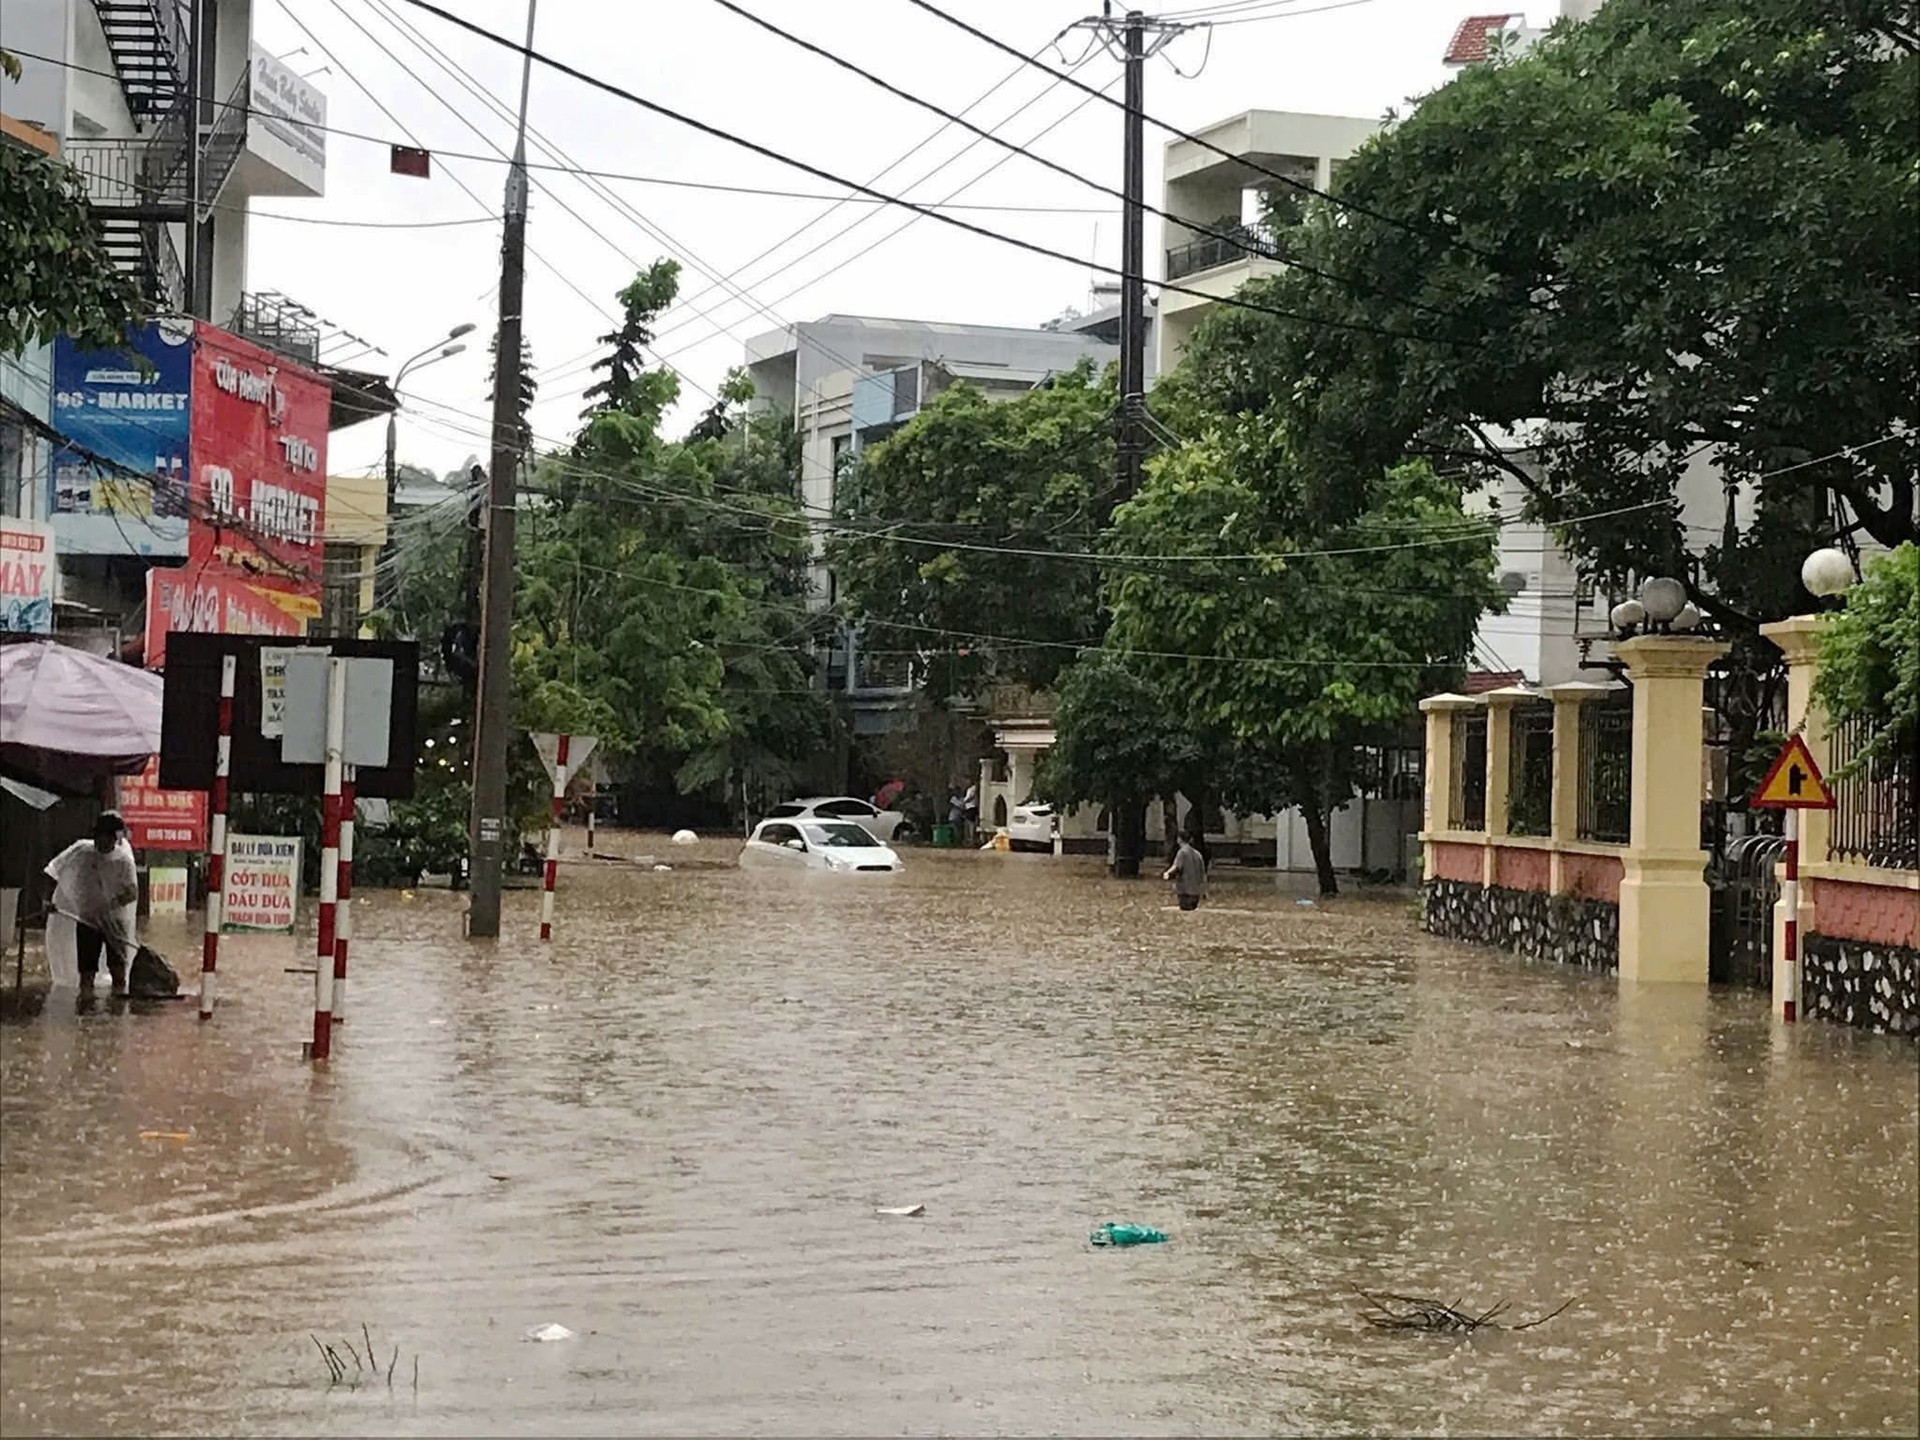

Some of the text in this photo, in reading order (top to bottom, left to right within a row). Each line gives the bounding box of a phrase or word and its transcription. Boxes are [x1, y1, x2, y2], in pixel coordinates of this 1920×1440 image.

[97, 391, 189, 411] MARKET
[201, 464, 233, 524] 90
[249, 479, 319, 547] MARKET
[230, 866, 258, 887] CỐT
